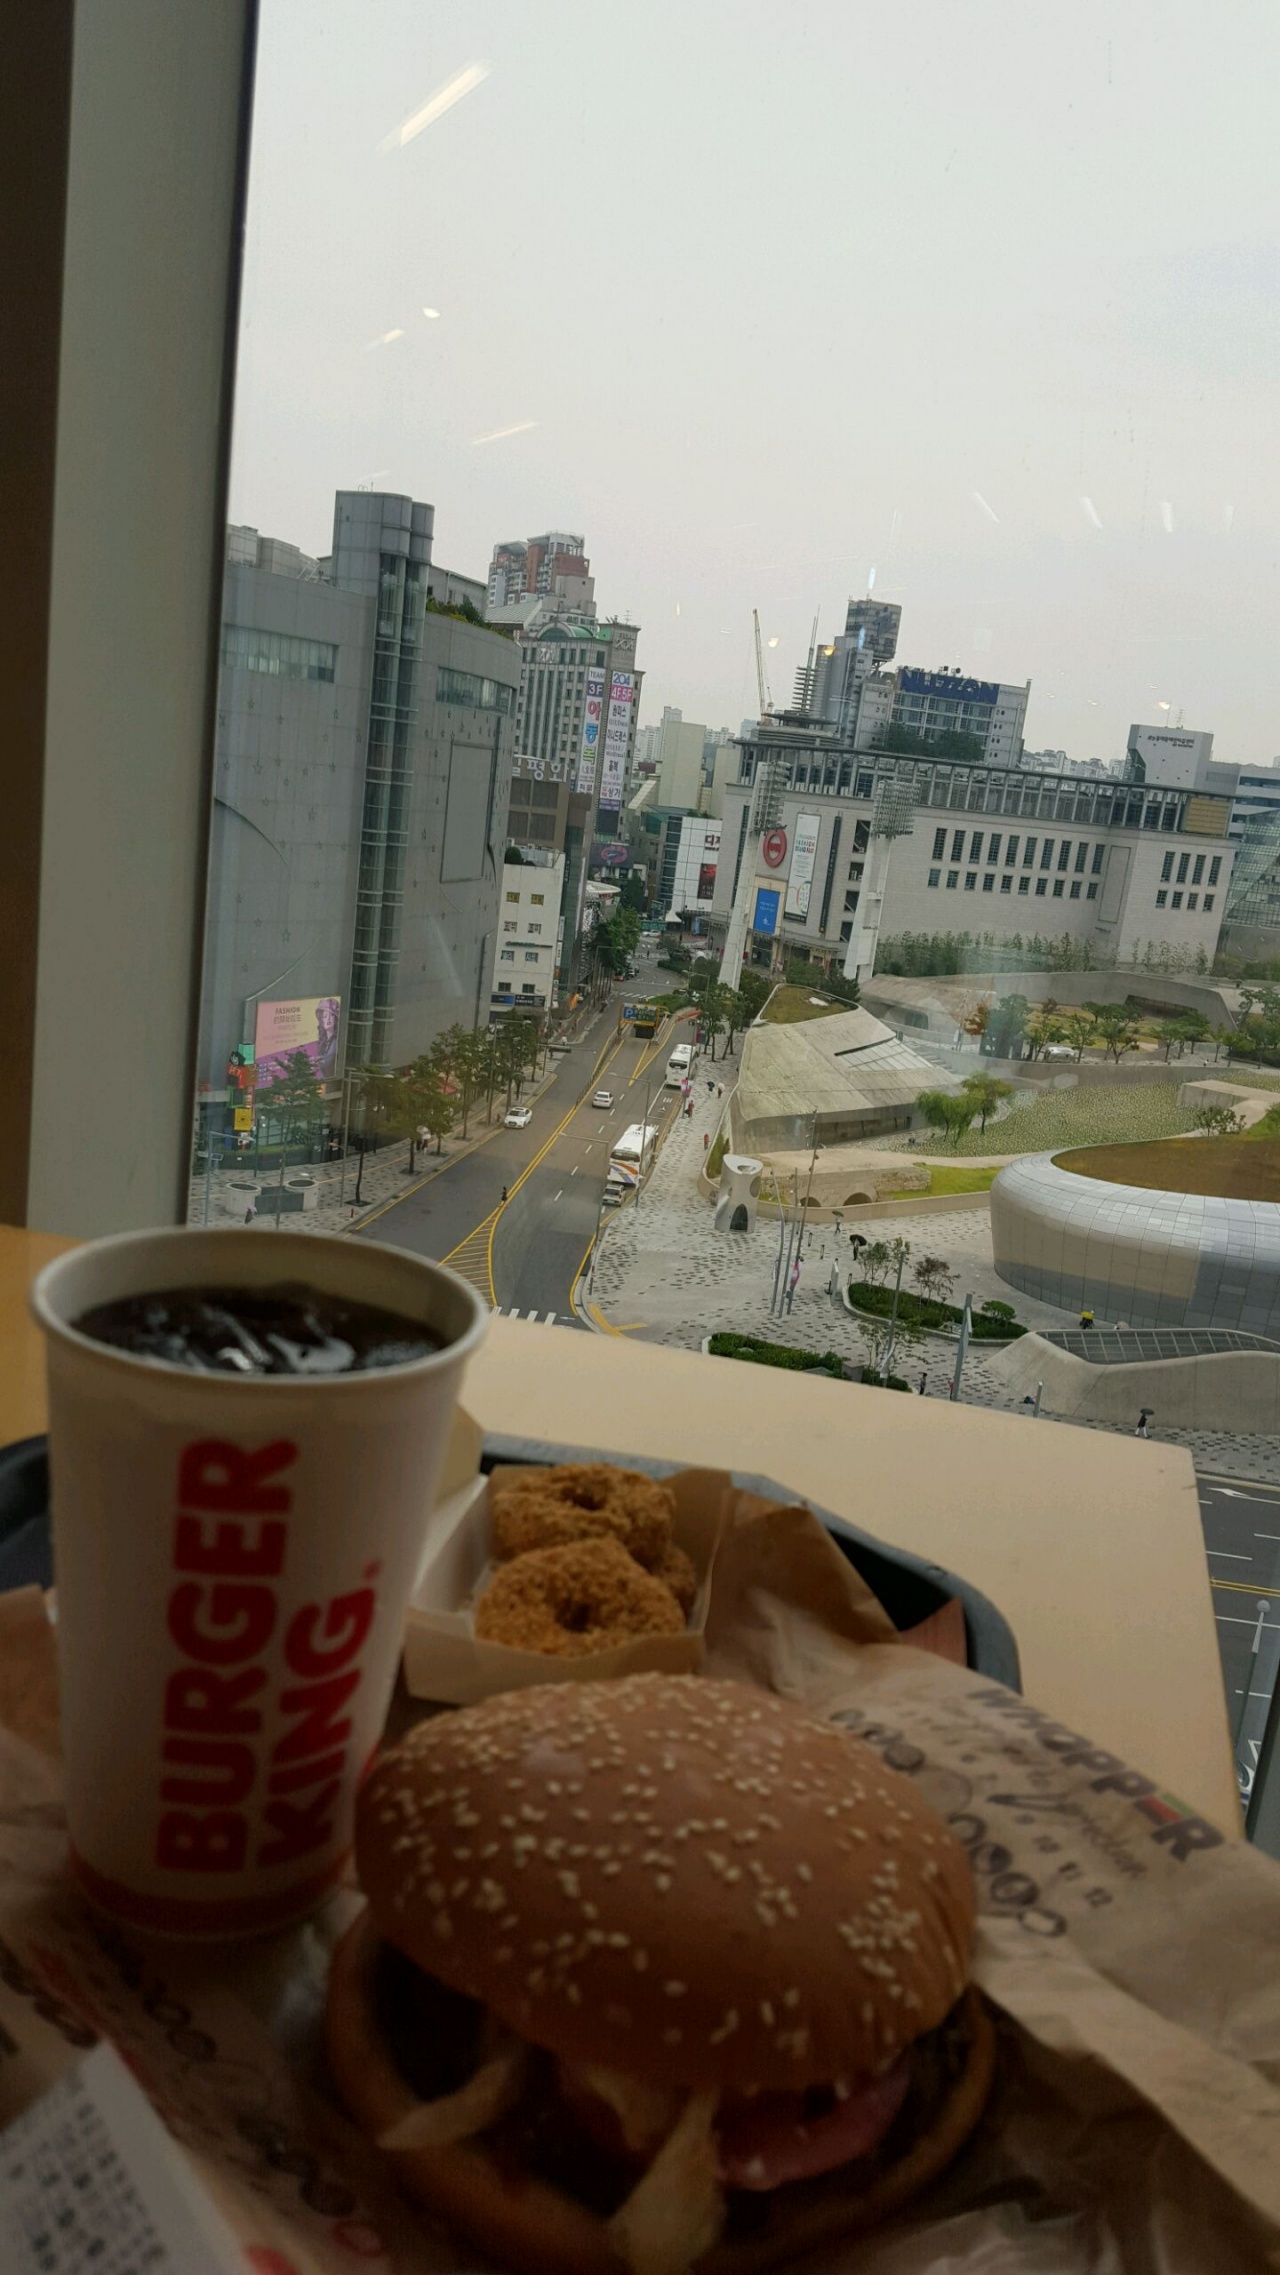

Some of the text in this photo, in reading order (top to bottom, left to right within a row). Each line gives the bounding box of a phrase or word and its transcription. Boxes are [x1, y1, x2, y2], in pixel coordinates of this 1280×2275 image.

[588, 684, 603, 696] 3F
[613, 672, 630, 686] 204
[583, 700, 601, 765] 아동복
[158, 1438, 297, 1872] BURGER
[257, 1586, 376, 1869] KING
